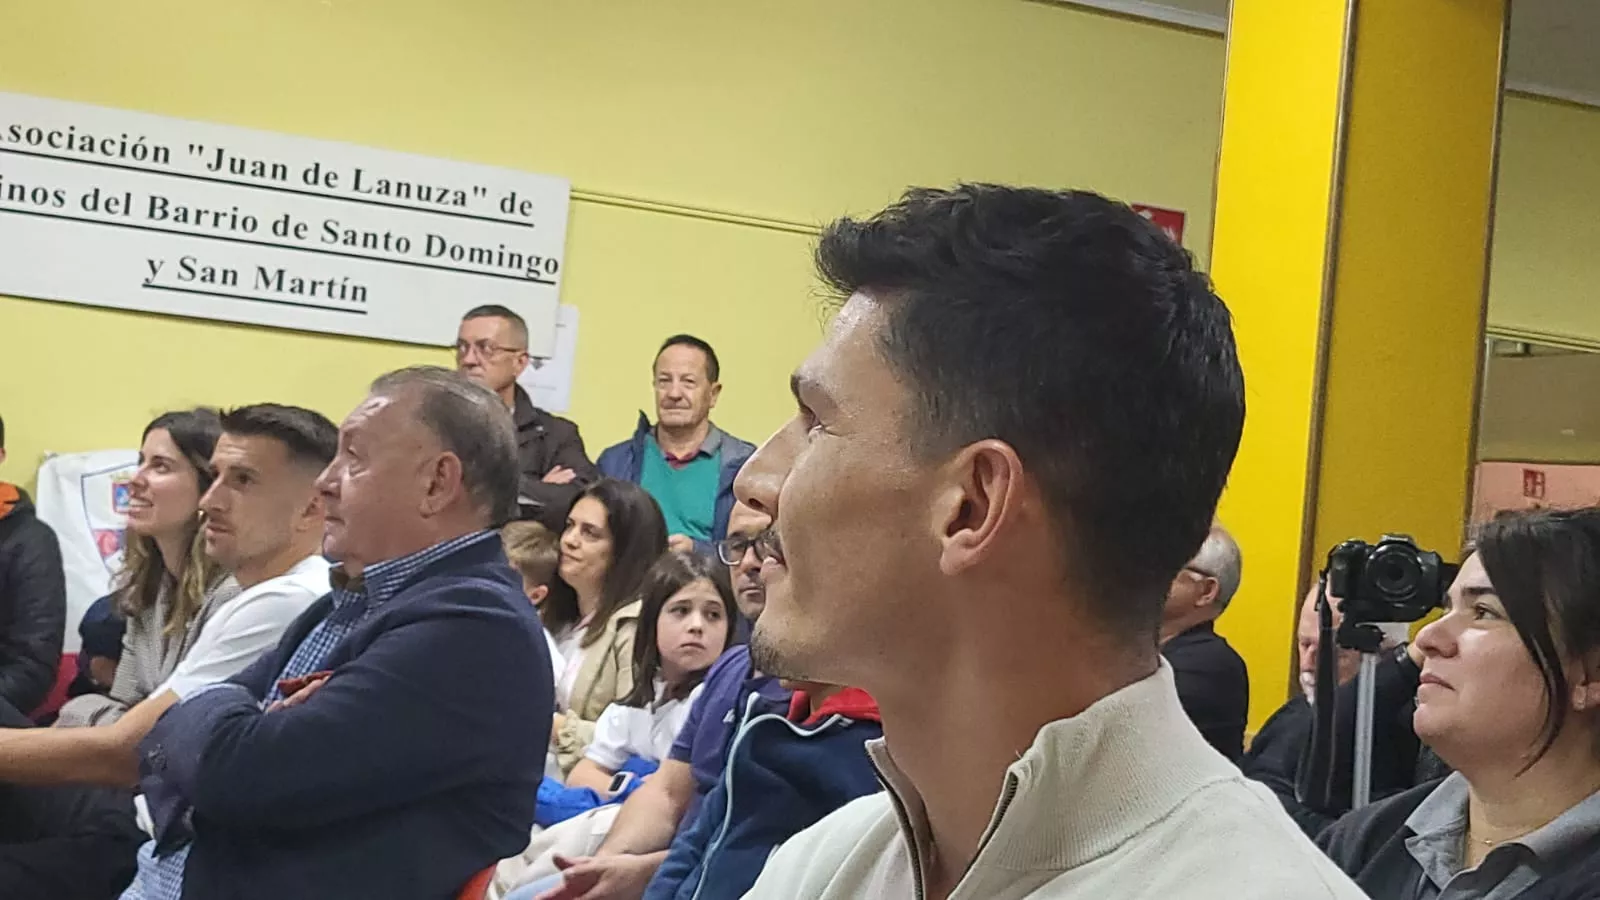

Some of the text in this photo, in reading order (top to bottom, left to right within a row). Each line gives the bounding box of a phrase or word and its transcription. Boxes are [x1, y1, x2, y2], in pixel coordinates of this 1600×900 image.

[0, 123, 534, 217] sociación "Juan de Lanuza" de
[80, 187, 131, 216] del
[147, 195, 259, 233] Barrio
[271, 214, 309, 241] de
[320, 219, 411, 254] Santo
[425, 234, 560, 279] Domingo
[144, 255, 368, 303] y San Martín
